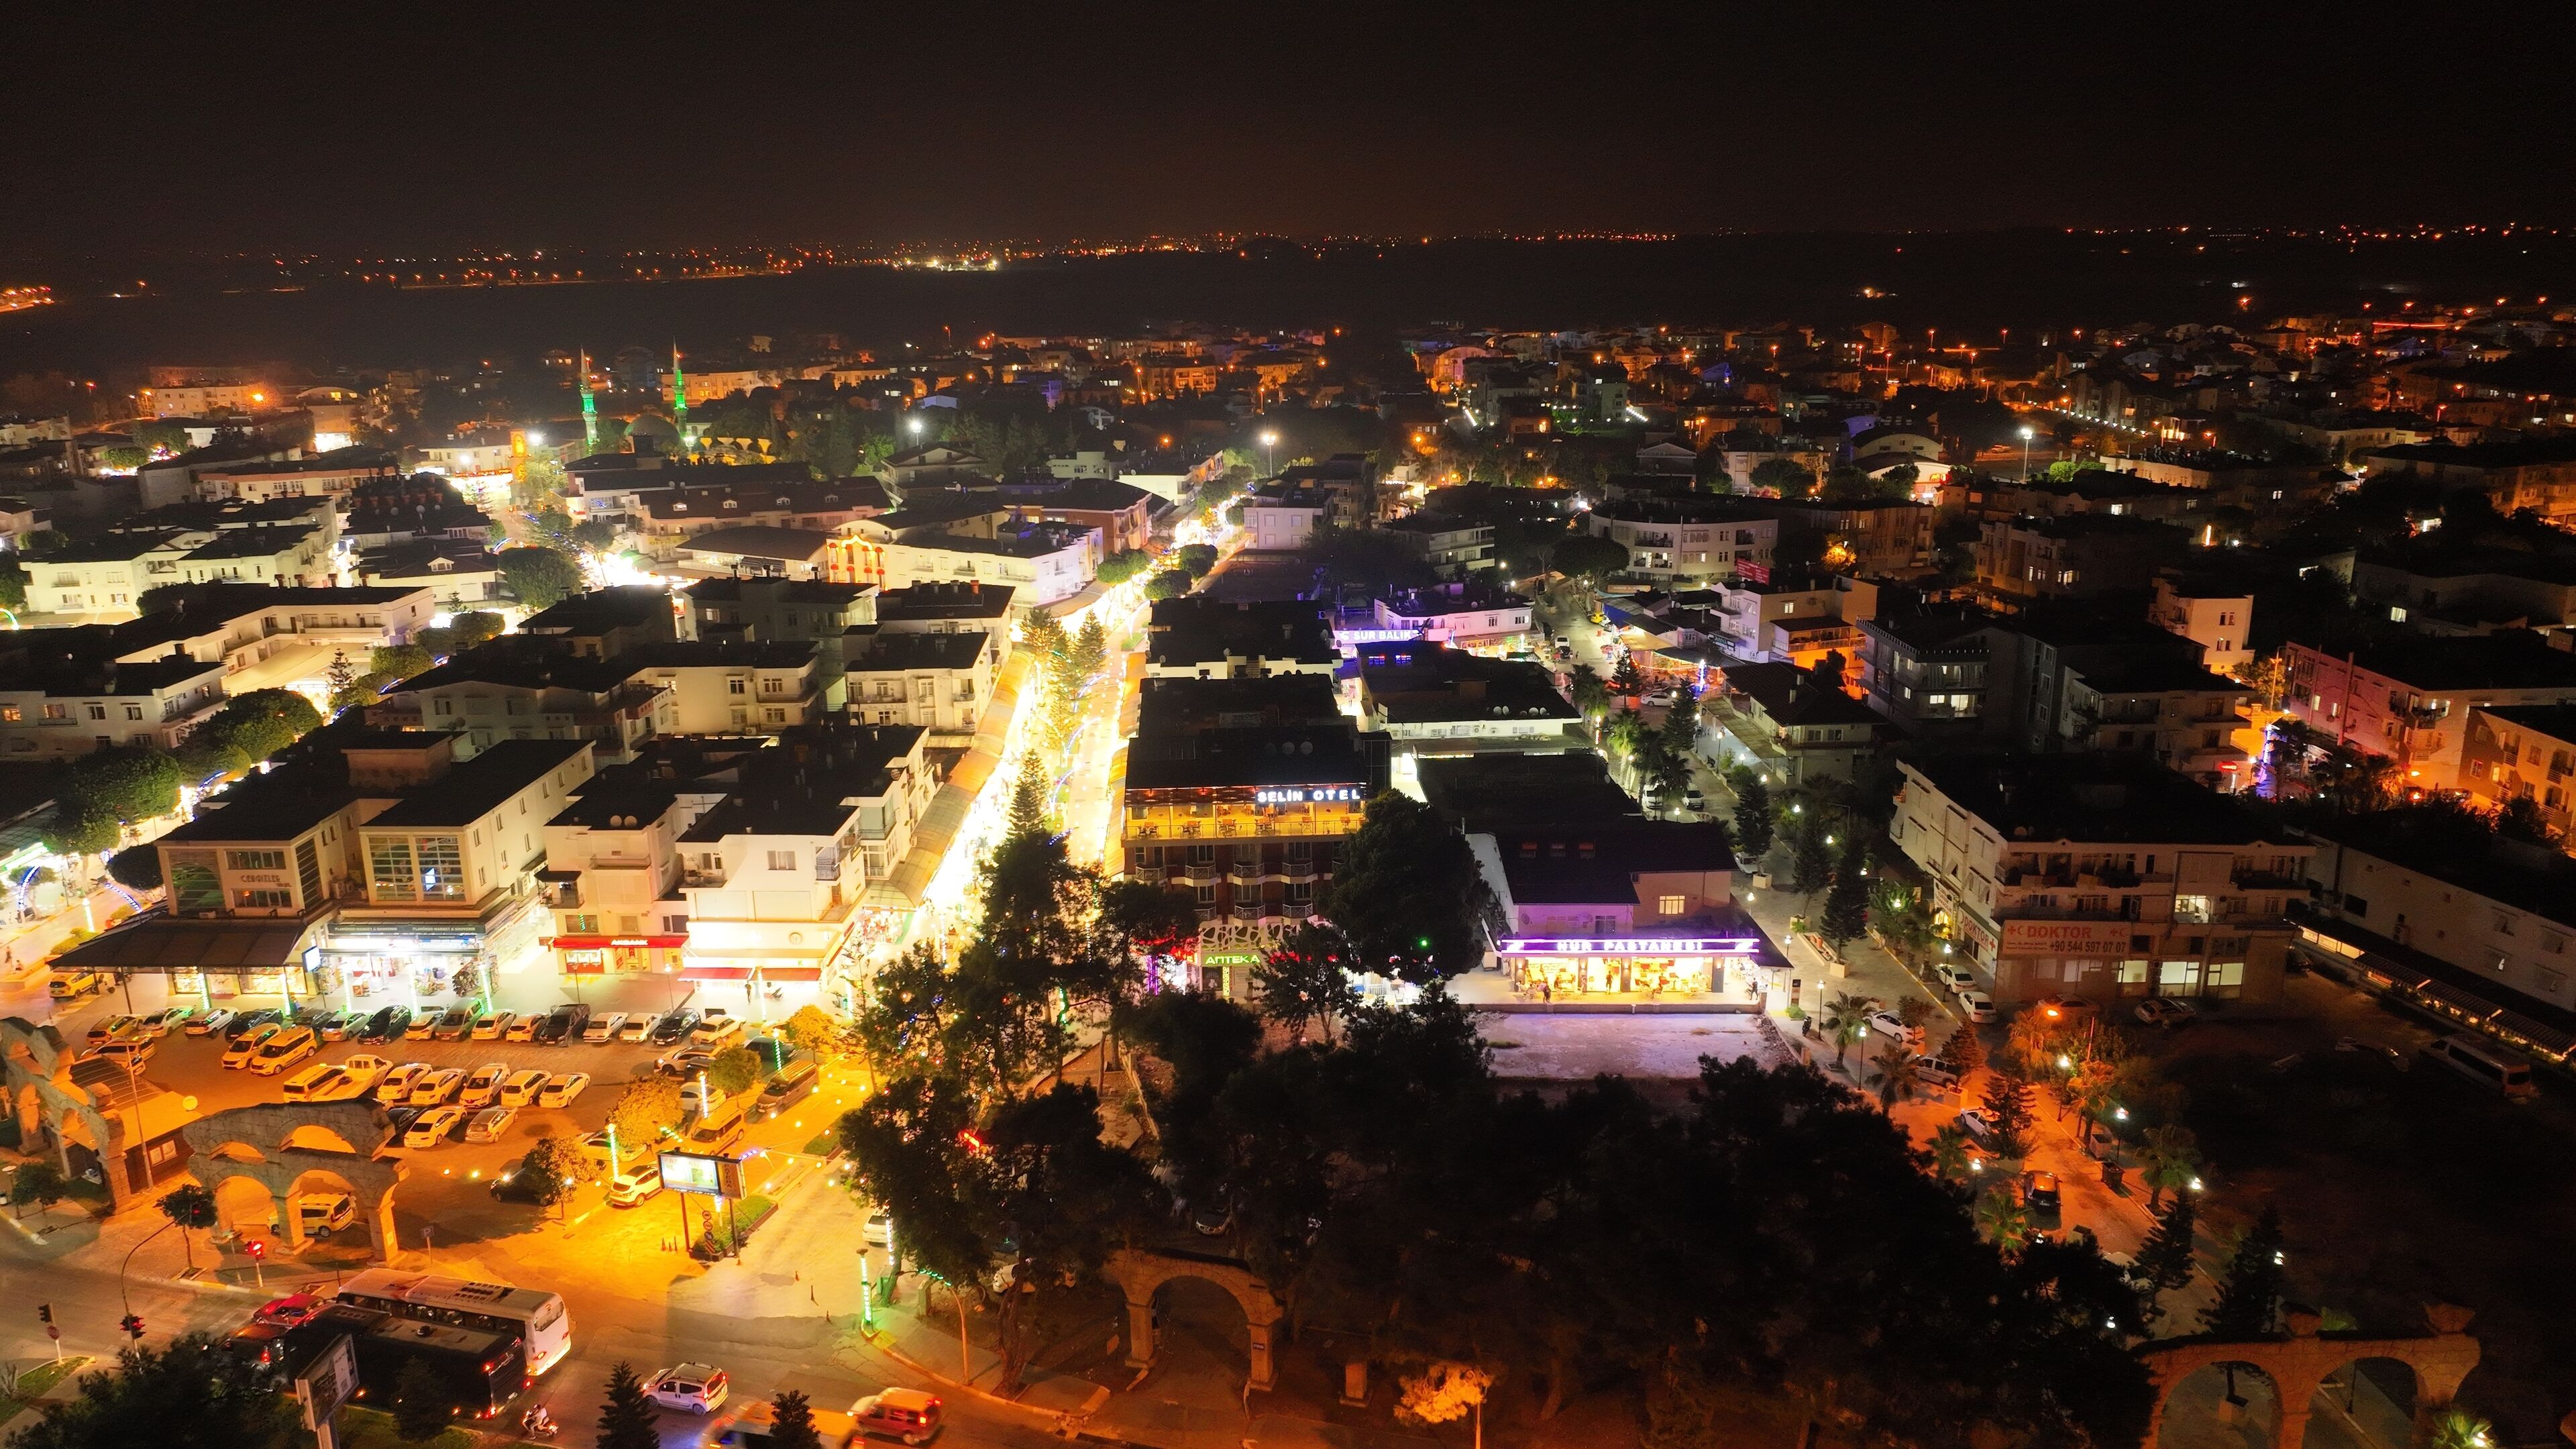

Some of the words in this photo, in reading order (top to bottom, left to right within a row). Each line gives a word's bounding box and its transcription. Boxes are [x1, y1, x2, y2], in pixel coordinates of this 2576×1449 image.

[1353, 631, 1376, 641] SUR
[1379, 631, 1411, 640] BALIK
[1257, 789, 1303, 803] SELİN
[1313, 789, 1360, 801] OTEL
[2027, 925, 2092, 939] DOKTOR
[1557, 941, 1592, 951] NUR
[2049, 941, 2065, 953] +90
[2068, 941, 2083, 953] 544
[2085, 941, 2100, 953] 597
[2102, 941, 2113, 953] 07
[2116, 941, 2127, 953] 07
[1205, 955, 1260, 965] АПТЕКА
